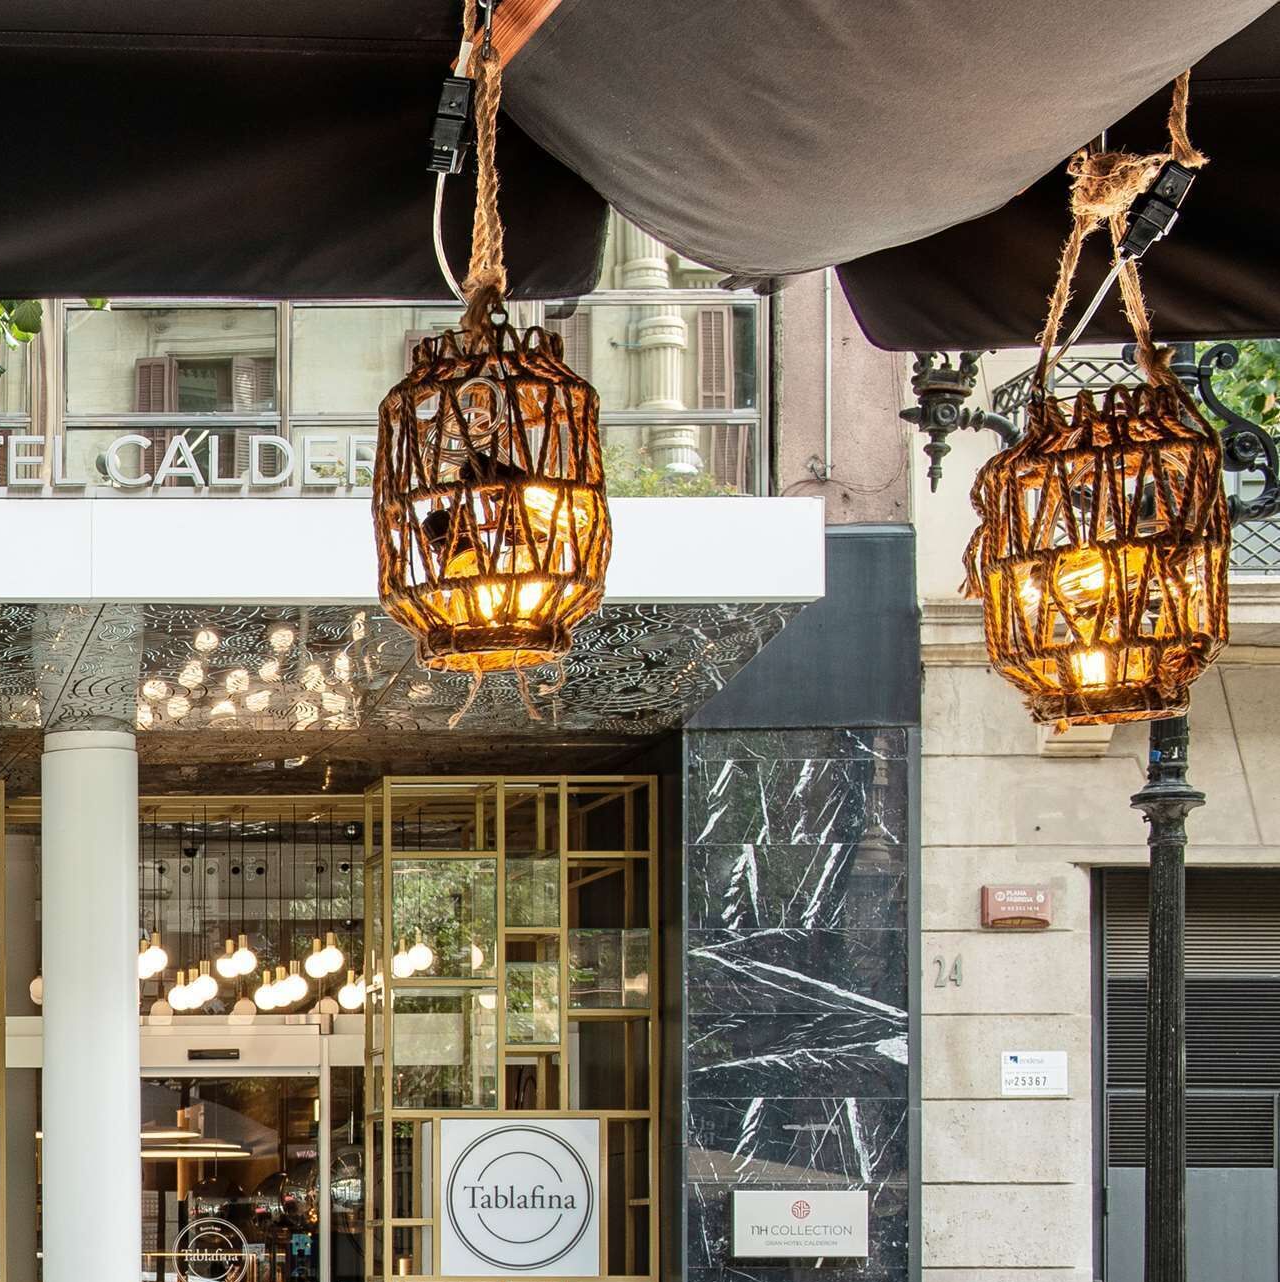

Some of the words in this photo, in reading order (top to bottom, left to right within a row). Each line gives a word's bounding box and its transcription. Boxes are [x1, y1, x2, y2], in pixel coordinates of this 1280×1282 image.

[105, 434, 378, 488] CALDER
[932, 953, 963, 989] 24
[463, 1184, 577, 1210] Tablafina
[770, 1225, 853, 1236] COLLECTION
[181, 1248, 239, 1262] Tablafina
